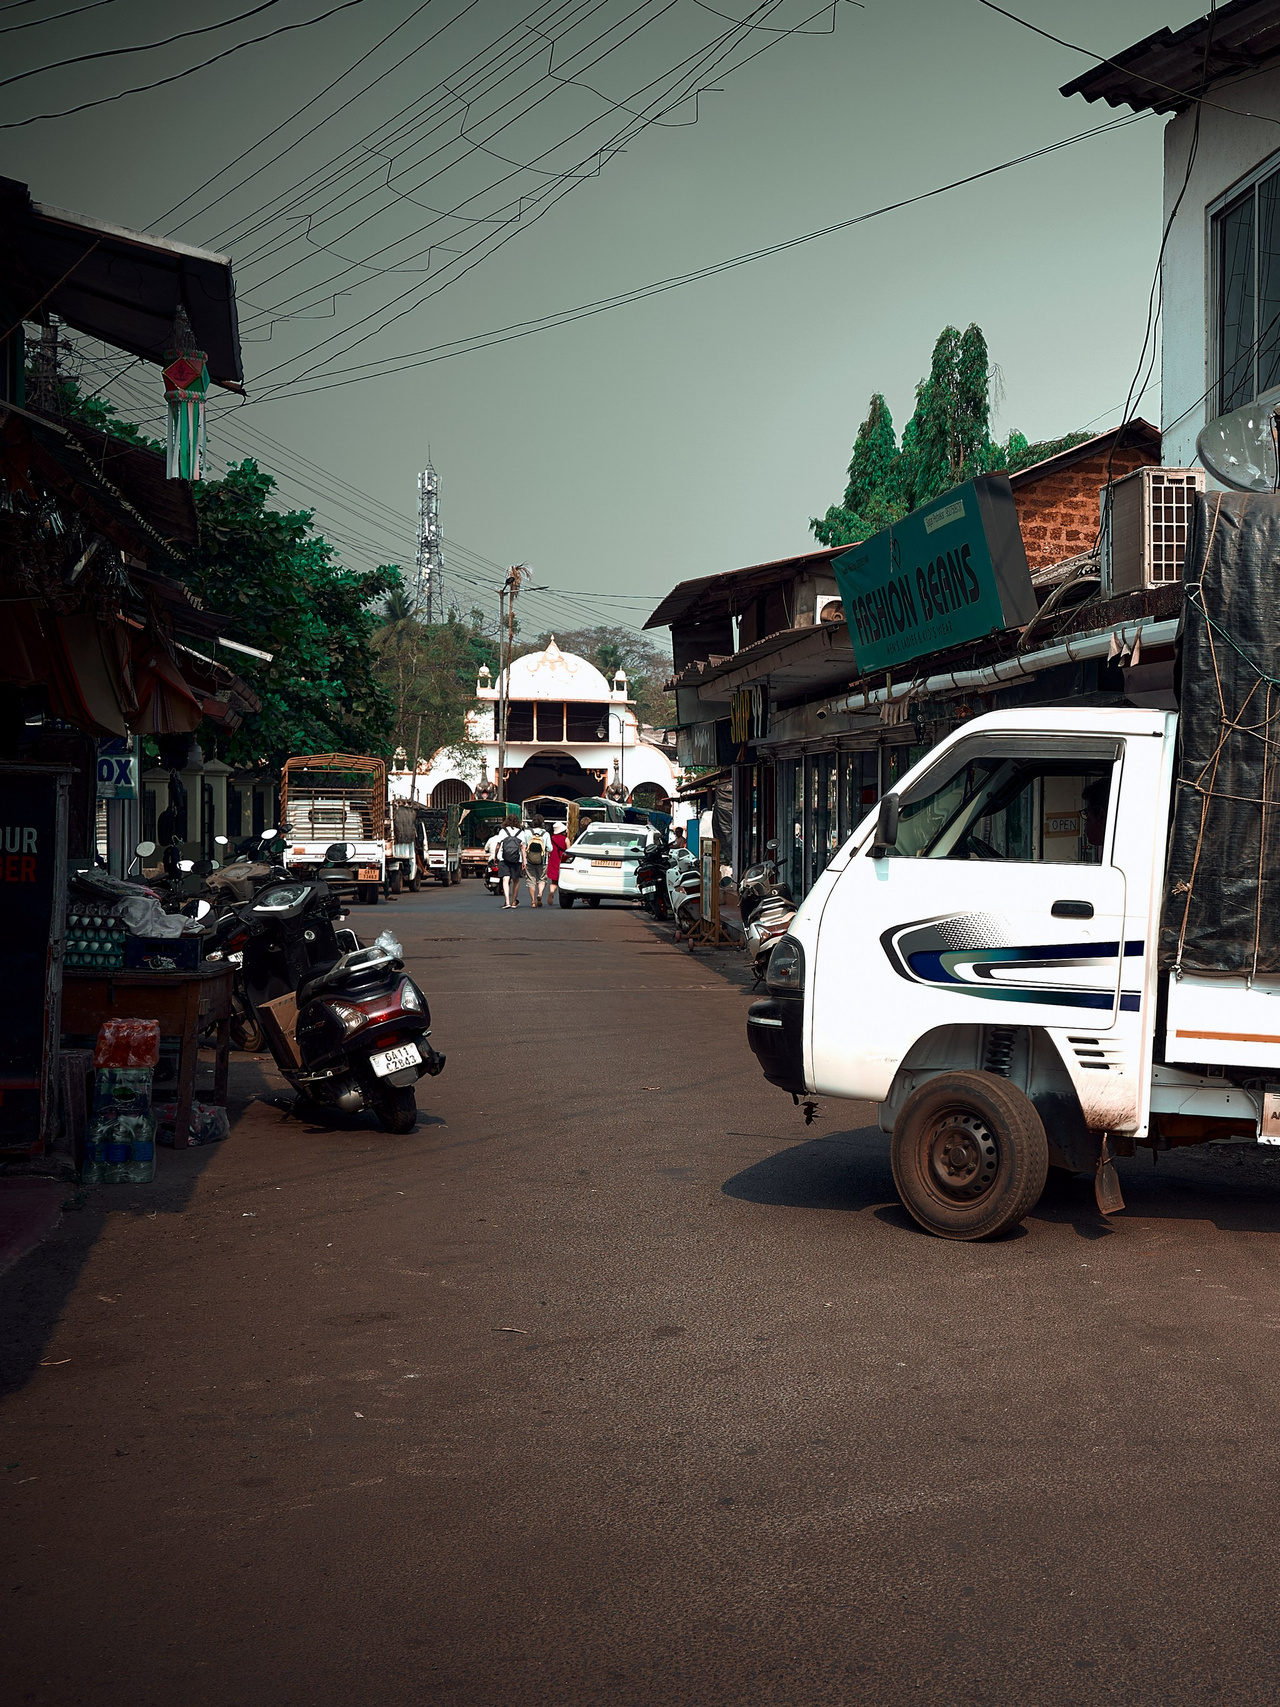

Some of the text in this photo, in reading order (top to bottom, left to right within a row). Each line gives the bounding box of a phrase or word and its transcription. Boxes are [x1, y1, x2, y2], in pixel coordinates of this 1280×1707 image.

[851, 543, 981, 647] FASHION BEANS
[730, 684, 763, 744] SHOP 99
[1052, 819, 1077, 831] OPEN
[385, 1047, 409, 1062] GA11
